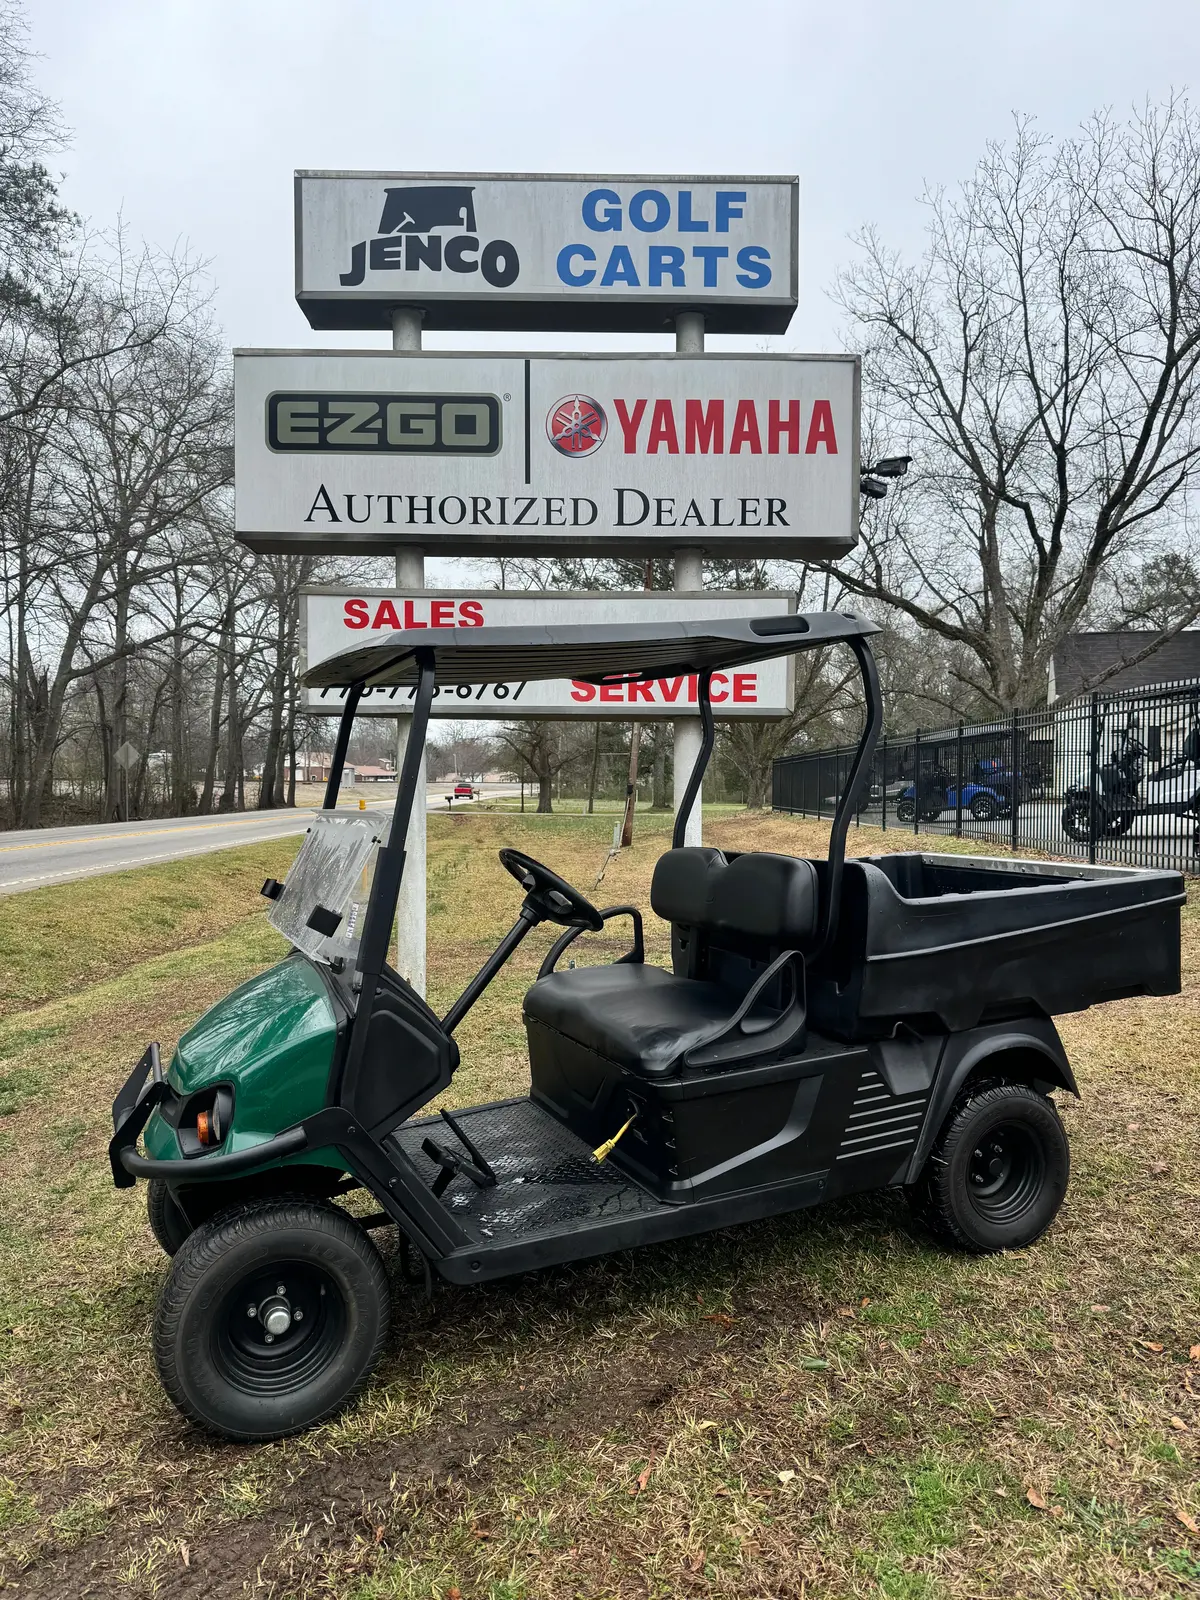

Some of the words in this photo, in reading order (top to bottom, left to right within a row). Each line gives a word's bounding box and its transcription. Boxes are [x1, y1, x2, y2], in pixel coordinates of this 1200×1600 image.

[582, 188, 748, 234] GOLF
[339, 234, 521, 289] JENCO
[556, 243, 773, 290] CARTS
[612, 398, 838, 456] YAMAHA
[304, 483, 599, 527] AUTHORIZED
[612, 488, 791, 528] DEALER
[343, 598, 485, 630] SALES
[569, 673, 758, 704] SERVICE
